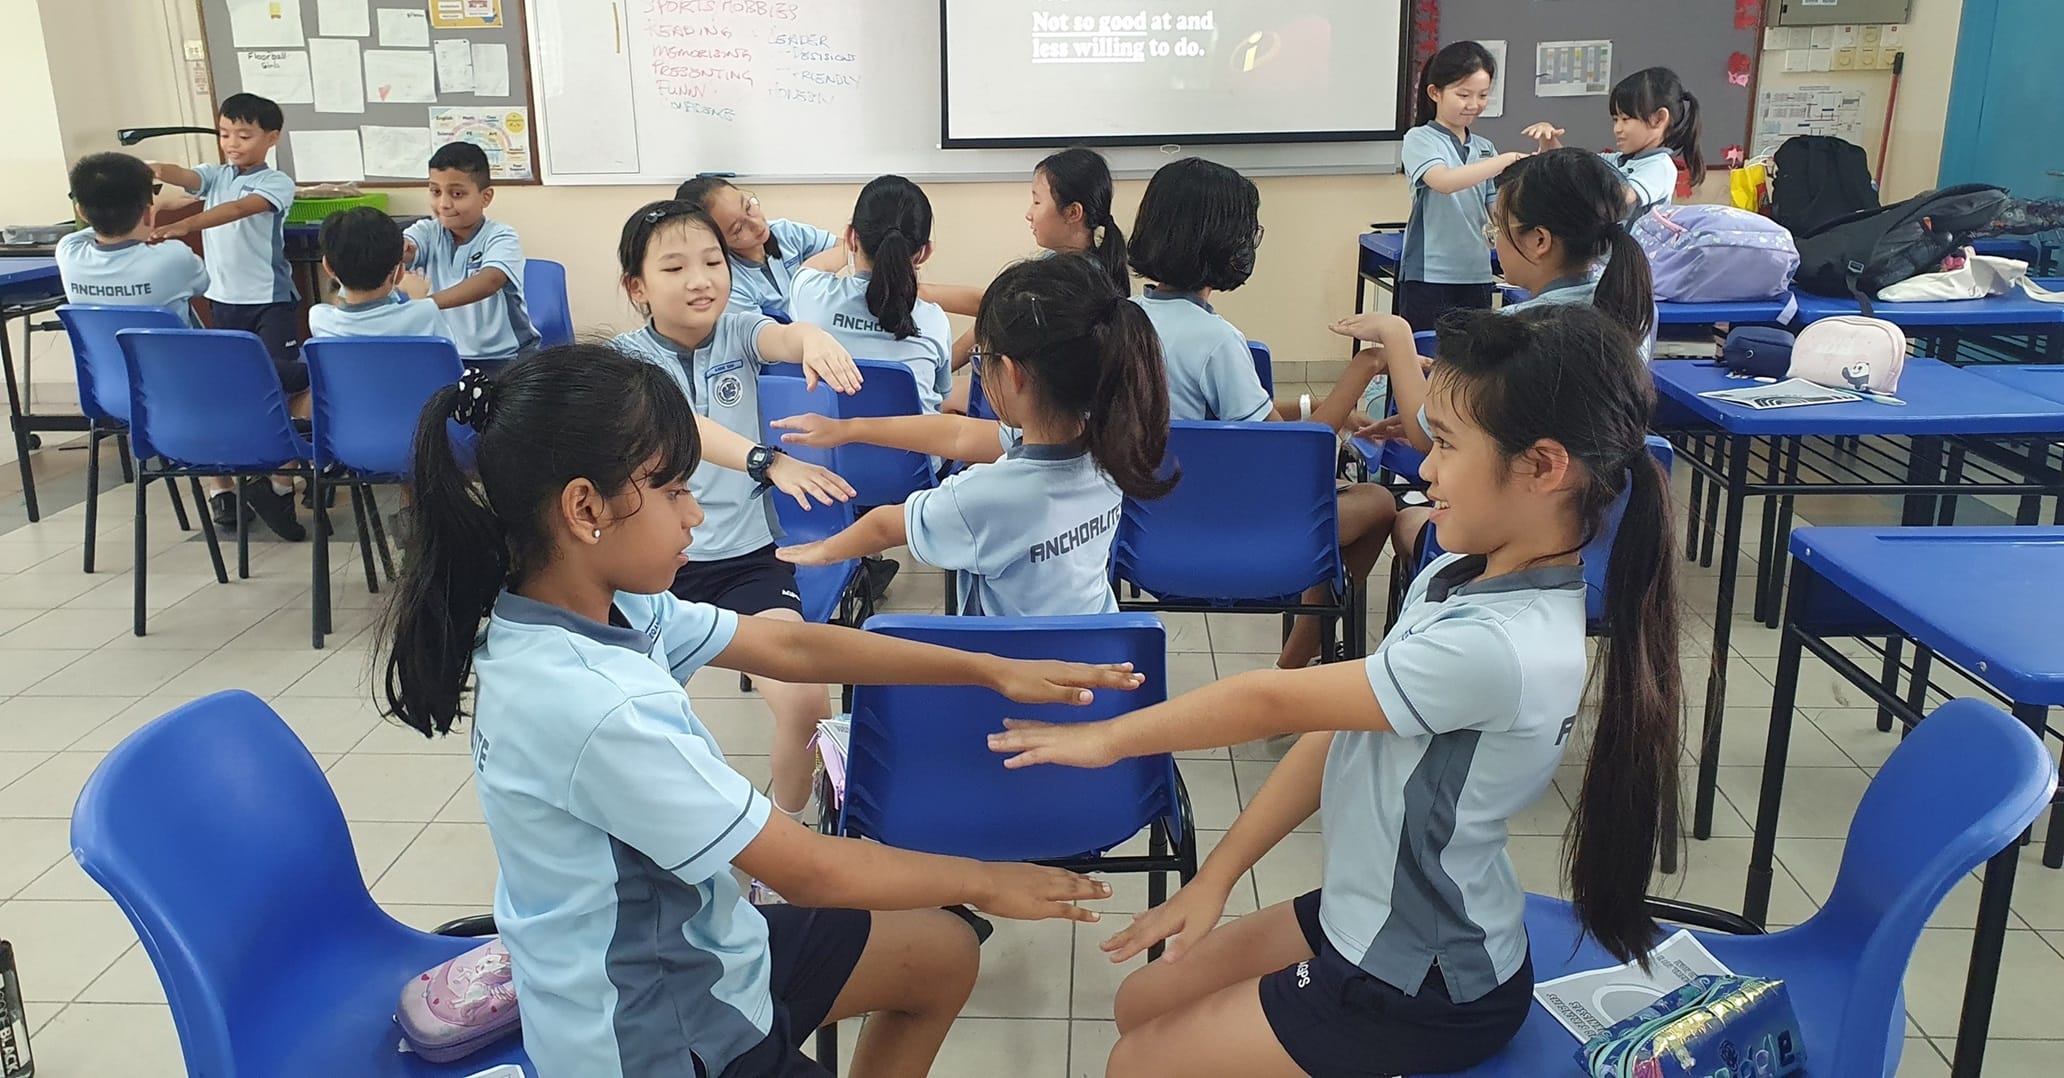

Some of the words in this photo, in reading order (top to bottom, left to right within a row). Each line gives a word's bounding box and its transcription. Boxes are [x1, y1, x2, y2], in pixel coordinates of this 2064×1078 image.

[1031, 11, 1070, 32] Not
[1073, 15, 1095, 32] so
[1099, 10, 1147, 35] good
[1150, 12, 1172, 31] at
[1176, 10, 1214, 31] and
[1031, 37, 1069, 58] less
[1073, 37, 1145, 60] willing
[1149, 40, 1170, 57] to
[1174, 37, 1205, 57] do.
[70, 282, 153, 298] ANCHORLITE
